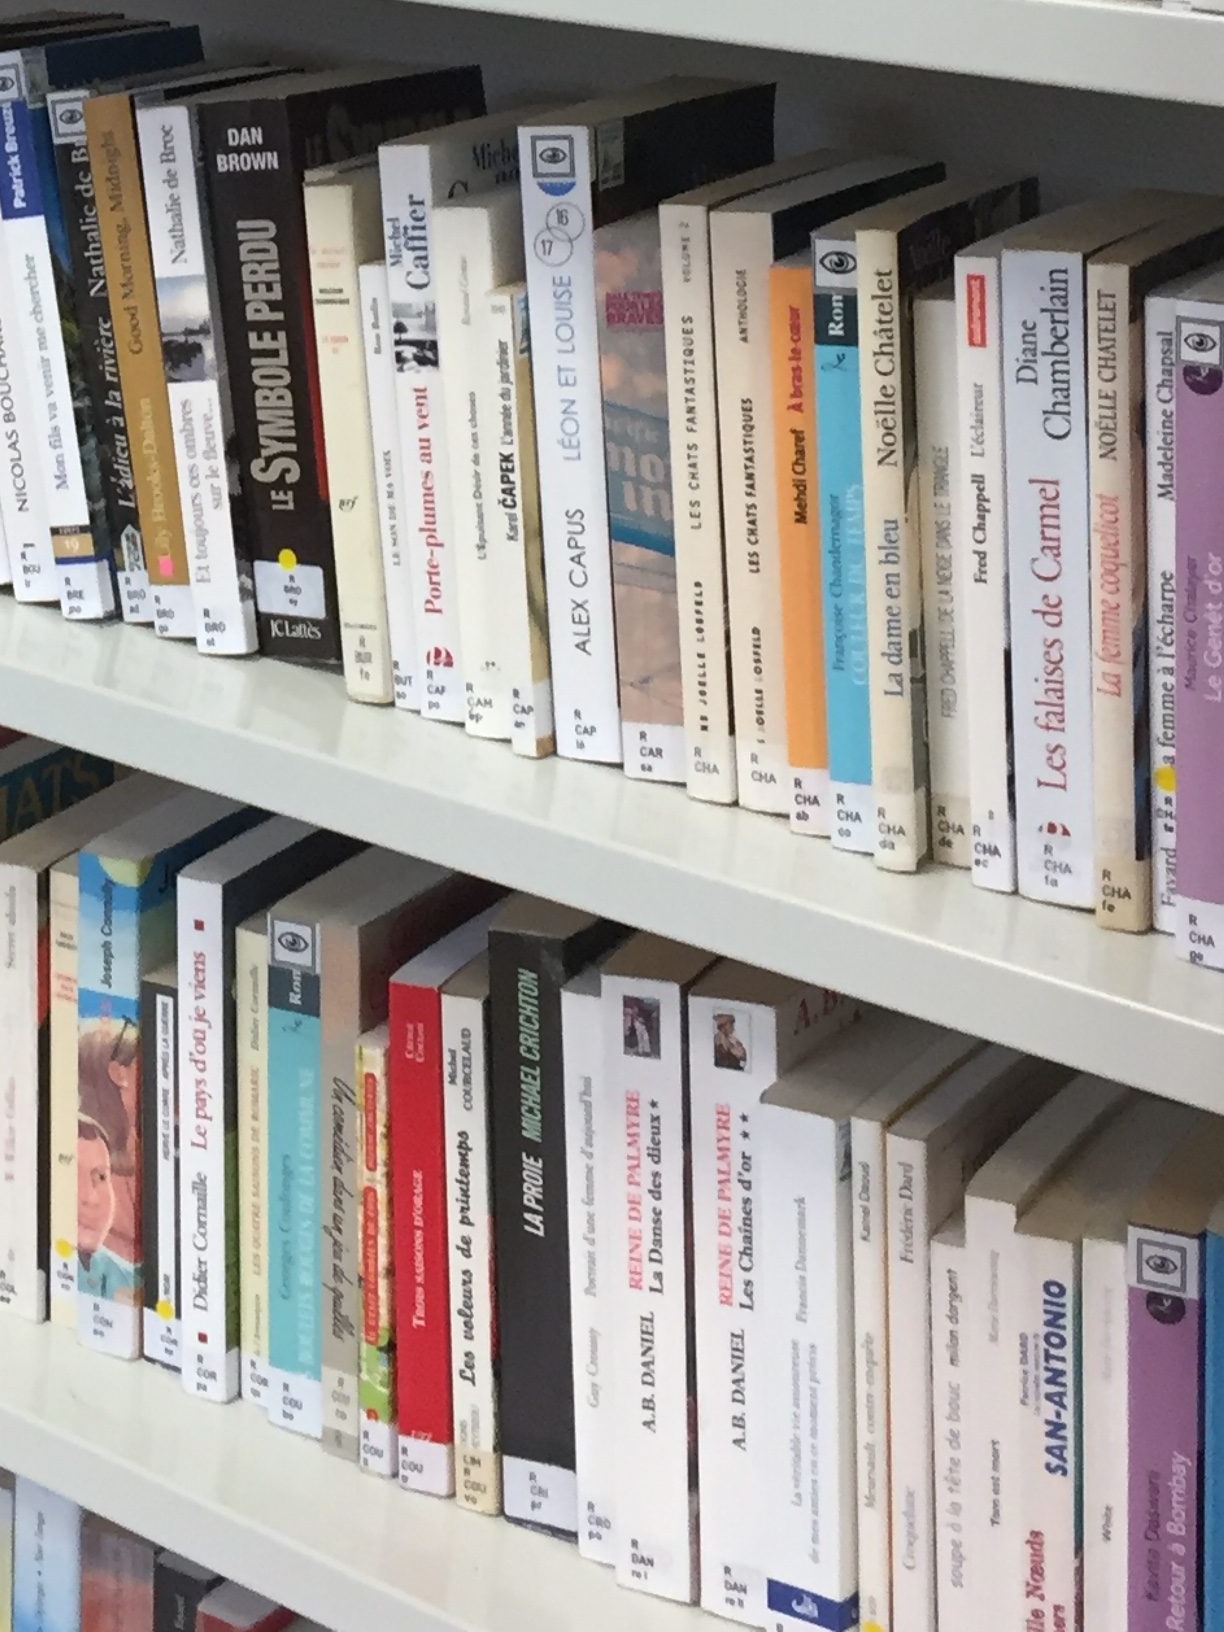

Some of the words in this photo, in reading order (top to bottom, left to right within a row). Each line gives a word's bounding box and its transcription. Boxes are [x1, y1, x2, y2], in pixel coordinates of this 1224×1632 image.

[216, 152, 279, 172] BROWN
[227, 127, 263, 146] DAN
[387, 216, 403, 268] Michel
[403, 192, 432, 290] Caffier
[235, 218, 282, 322] PERDU
[551, 274, 577, 354] LOUISE
[869, 267, 896, 377] Châtelet
[1096, 289, 1117, 384] CHATELET
[556, 359, 578, 388] ET
[680, 314, 698, 434] FANTASTIQUES
[1014, 319, 1040, 385] Diane
[1040, 267, 1072, 441] Chamberlain
[245, 329, 302, 484] SYMBOLE
[410, 386, 433, 431] vent
[553, 395, 582, 462] LÉON
[872, 384, 899, 468] Noëlle
[1092, 389, 1118, 461] NOËLLE
[4, 428, 30, 513] NICOLAS
[418, 435, 434, 465] au
[684, 442, 701, 491] CHATS
[790, 428, 808, 475] Charef
[271, 489, 296, 510] LE
[496, 450, 518, 510] ČAPEK
[792, 478, 809, 524] Mehdi
[687, 497, 703, 530] LES
[878, 518, 900, 564] bleu
[1028, 477, 1063, 584] Carmel
[415, 469, 445, 616] Porte-plumes
[564, 508, 589, 588] CAPUS
[882, 569, 900, 599] en
[1033, 592, 1062, 629] de
[569, 598, 593, 656] ALEX
[881, 604, 902, 668] dame
[882, 670, 905, 698] La
[1034, 637, 1067, 733] falaises
[1037, 740, 1068, 791] Les
[188, 950, 207, 1004] viens
[190, 1007, 212, 1026] je
[516, 968, 541, 1062] CRICHTON
[187, 1029, 209, 1073] d'où
[192, 1078, 213, 1120] pays
[520, 1064, 543, 1142] MICHAEL
[191, 1126, 208, 1151] Le
[625, 1089, 643, 1190] PALMYRE
[647, 1112, 663, 1166] dieux
[521, 1152, 545, 1203] PROIE
[647, 1171, 663, 1201] des
[737, 1151, 753, 1193] d'or
[189, 1171, 209, 1252] Cornaille
[522, 1208, 545, 1237] LA
[627, 1195, 642, 1227] DE
[648, 1208, 664, 1266] Danse
[737, 1196, 754, 1274] Chaînes
[190, 1256, 210, 1313] Didier
[627, 1234, 644, 1291] REINE
[649, 1270, 664, 1295] La
[739, 1277, 755, 1311] Les
[638, 1311, 656, 1389] DANIEL
[1043, 1280, 1069, 1477] SAN-ANTONIO
[642, 1393, 657, 1433] A.B.
